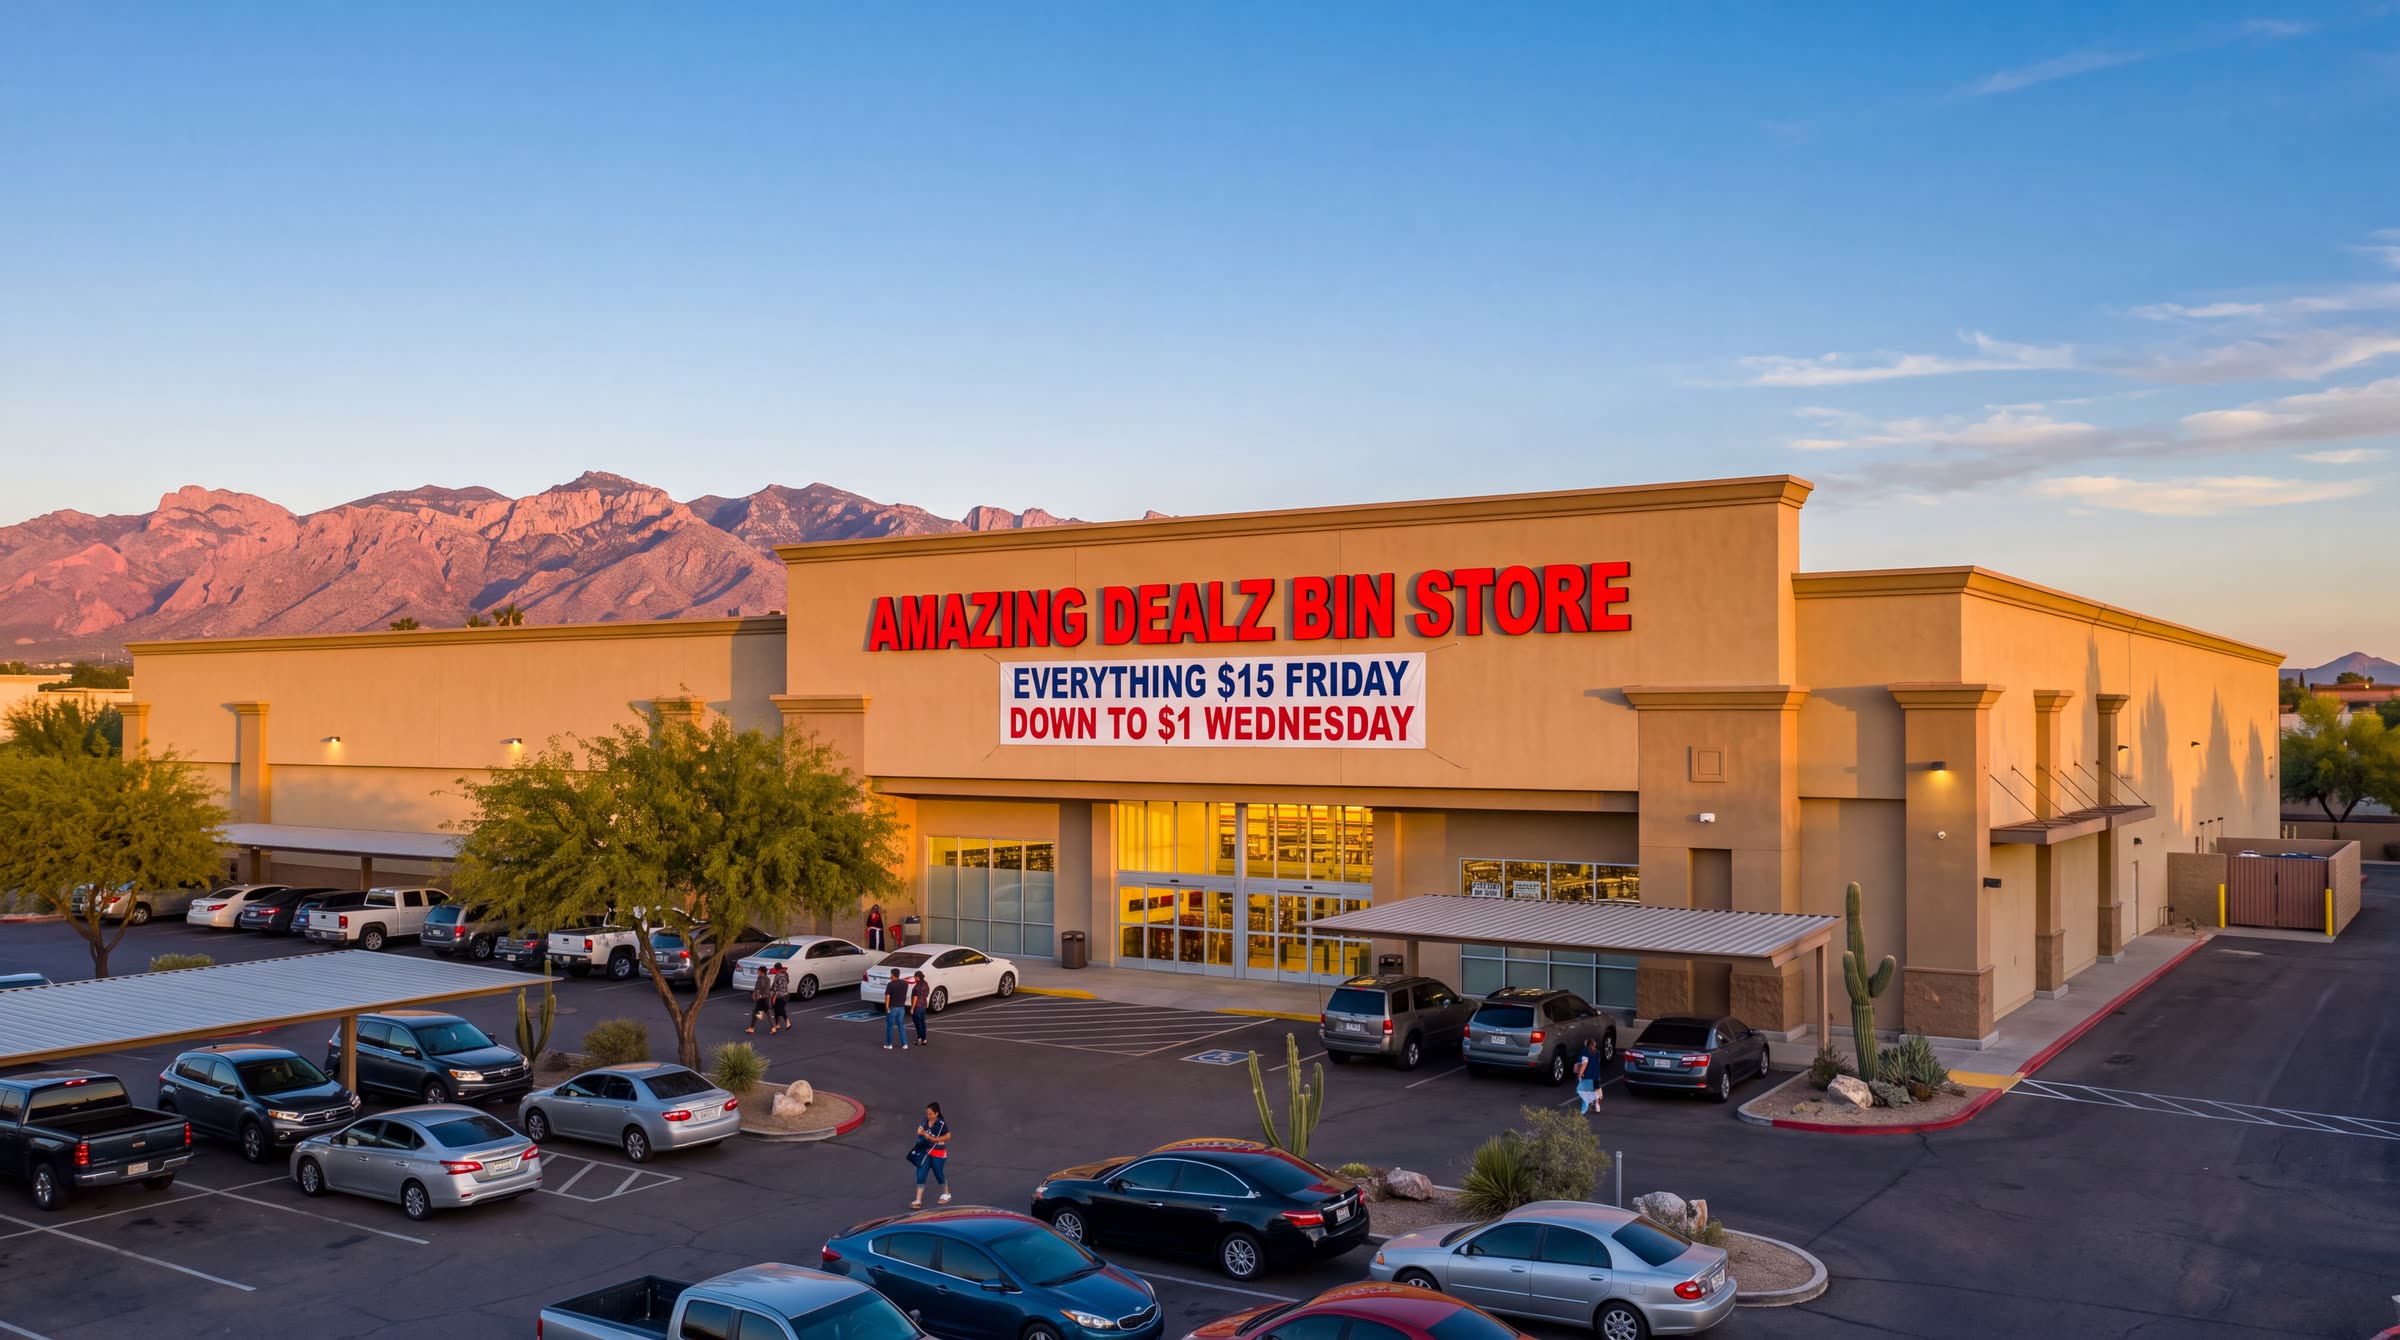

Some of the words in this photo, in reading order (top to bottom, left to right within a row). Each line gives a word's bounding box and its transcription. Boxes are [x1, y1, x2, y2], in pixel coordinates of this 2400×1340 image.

[868, 587, 1087, 653] AMAZING
[1102, 578, 1275, 646] DEALZ
[1292, 572, 1395, 641] BIN
[1414, 561, 1632, 639] STORE
[1014, 664, 1206, 700] EVERYTHING
[1216, 662, 1275, 702] $15
[1286, 660, 1409, 697] FRIDAY
[1010, 706, 1097, 741] DOWN
[1107, 706, 1148, 741] TO
[1157, 704, 1191, 744] $1
[1203, 704, 1415, 742] WEDNESDAY
